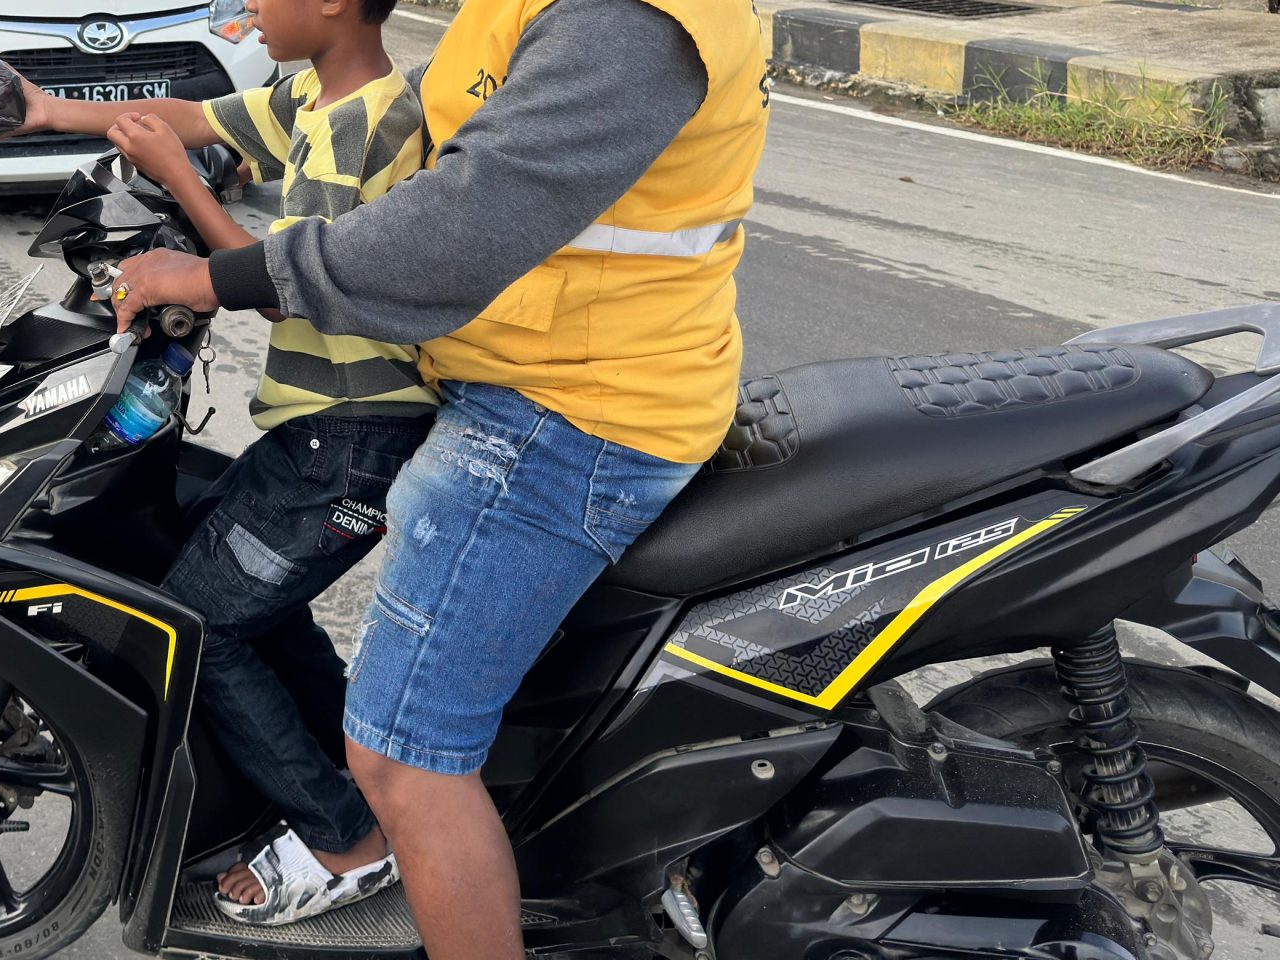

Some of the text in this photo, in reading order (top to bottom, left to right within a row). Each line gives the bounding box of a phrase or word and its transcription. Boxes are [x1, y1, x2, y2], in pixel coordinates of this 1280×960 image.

[82, 85, 128, 102] 1630
[142, 83, 167, 100] SM
[25, 375, 90, 416] YAMAHA
[934, 518, 1020, 560] 125
